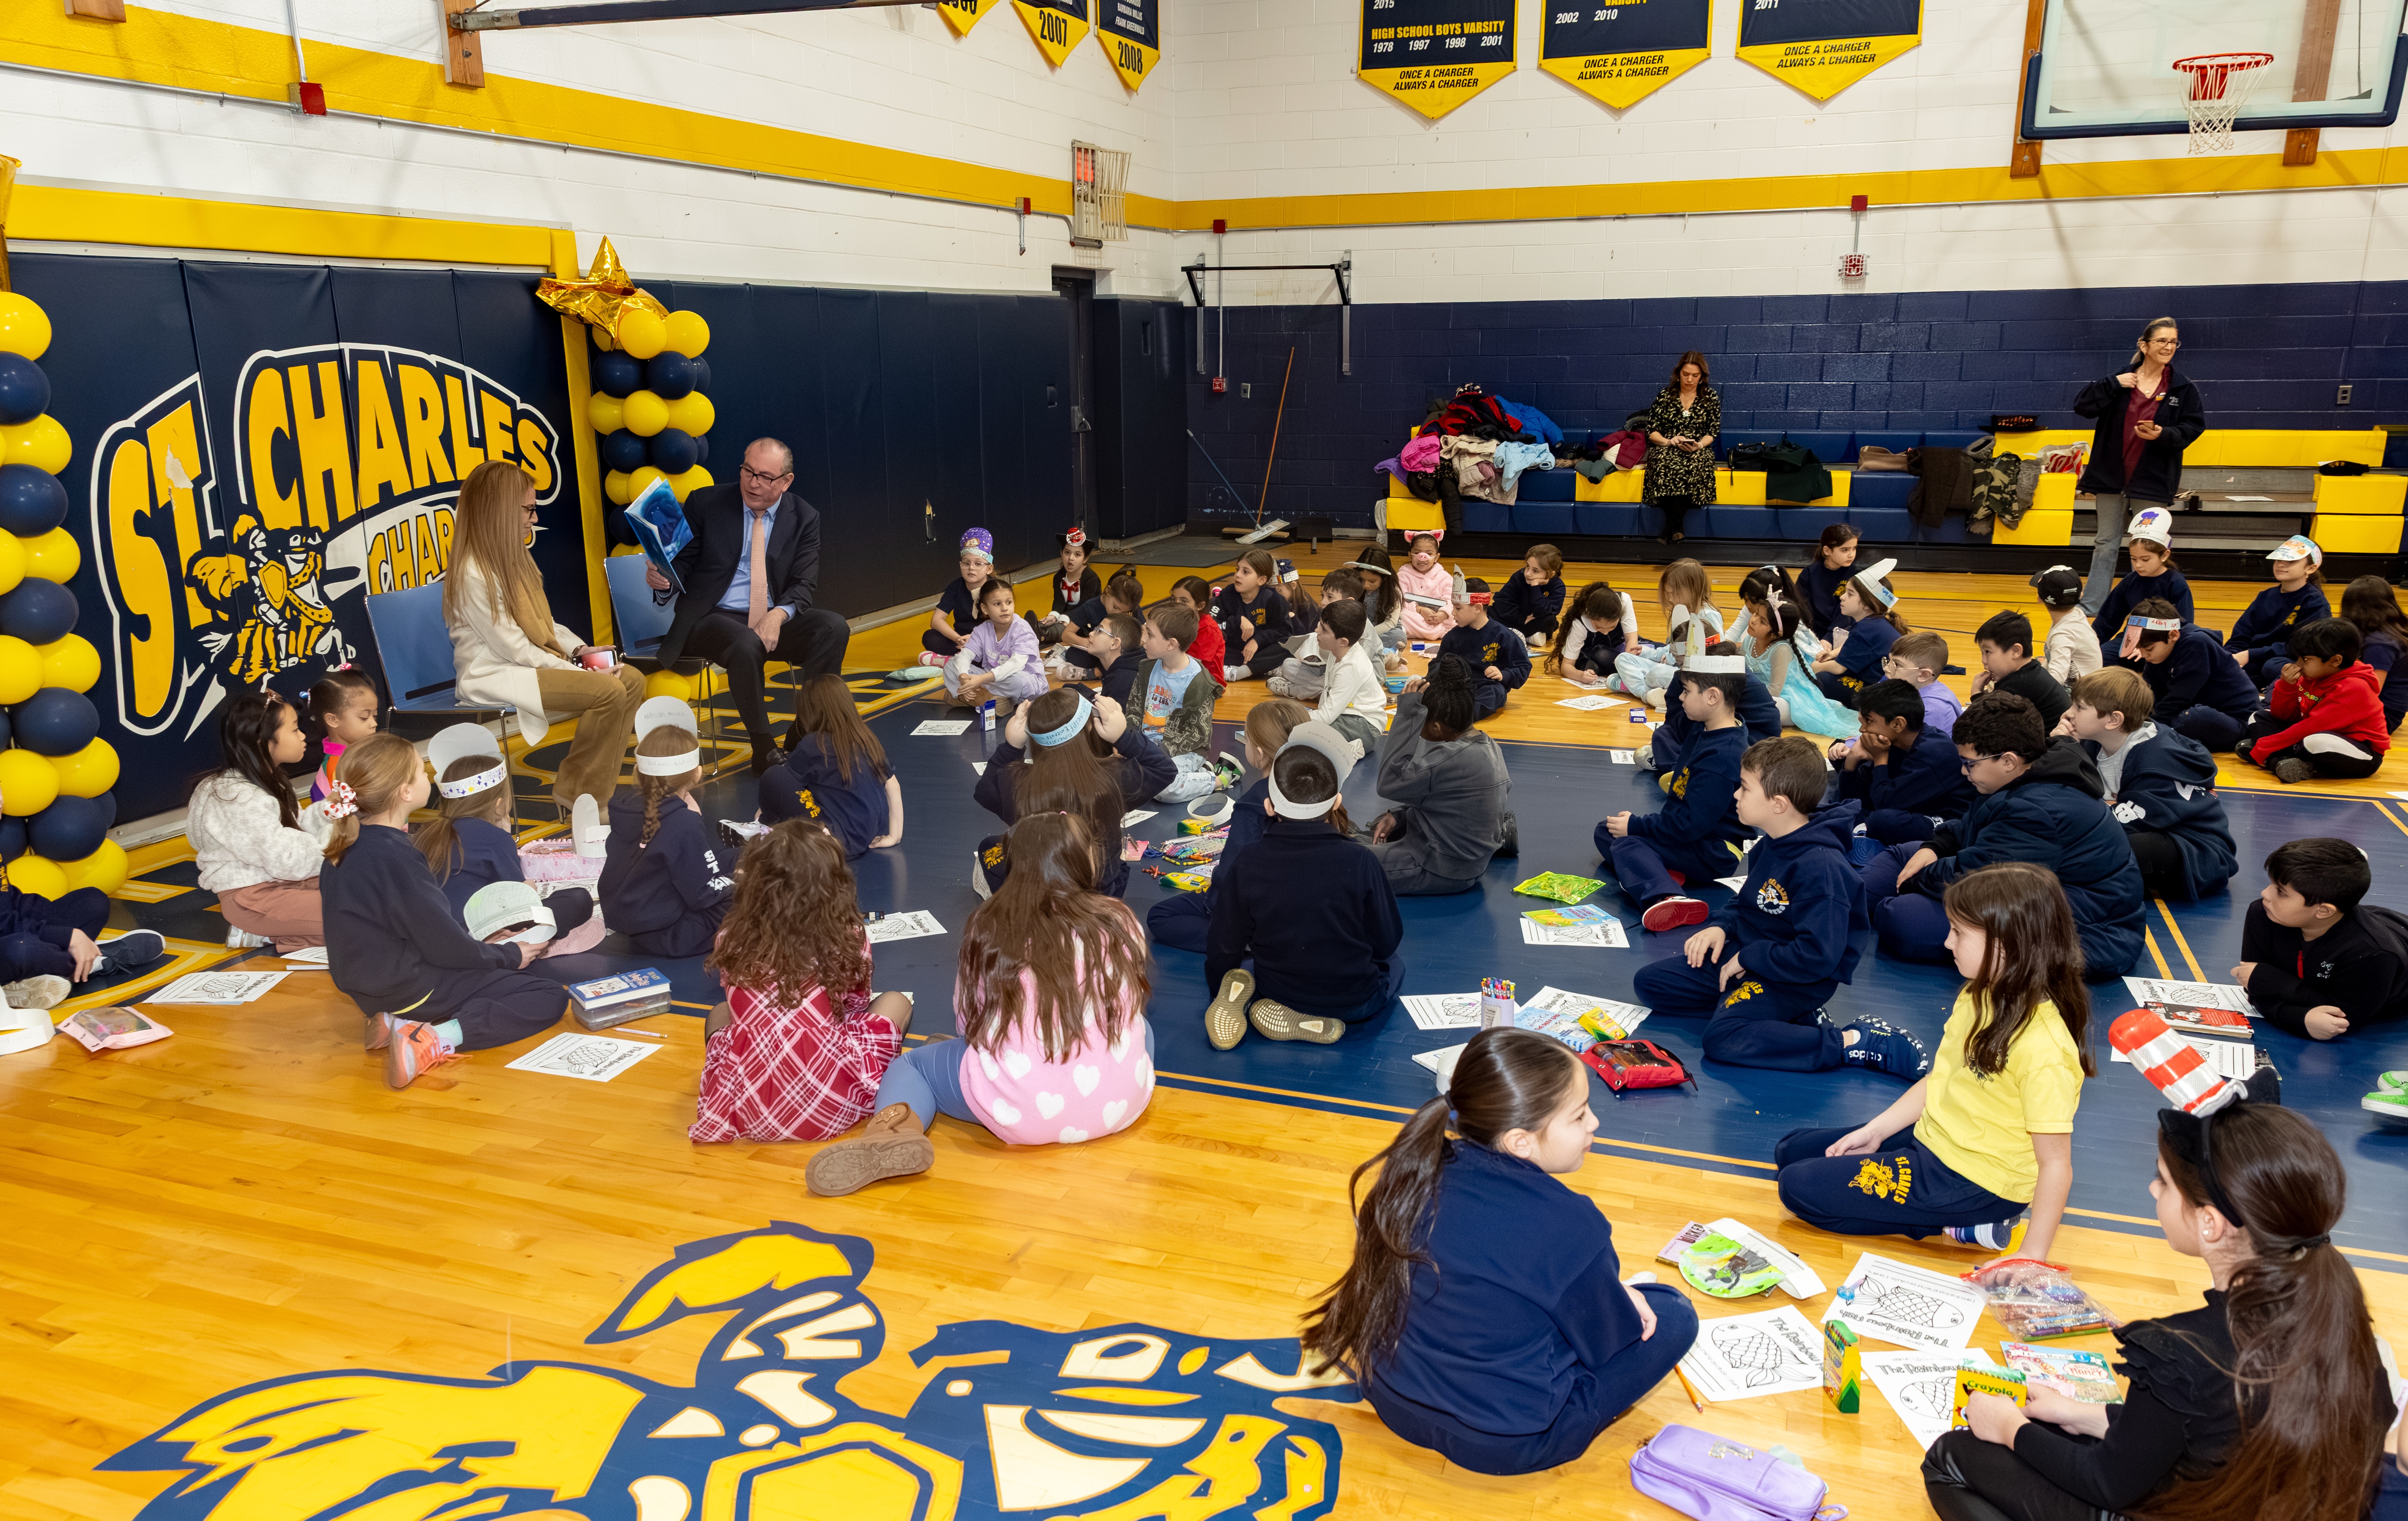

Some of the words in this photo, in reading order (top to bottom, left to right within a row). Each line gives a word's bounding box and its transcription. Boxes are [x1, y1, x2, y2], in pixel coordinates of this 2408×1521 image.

[1373, 0, 1394, 9] 2015
[1755, 0, 1779, 10] 2011
[1555, 12, 1579, 24] 2002
[1594, 9, 1618, 21] 2010
[1039, 10, 1067, 47] 2007
[1371, 27, 1395, 39] HIGH
[1397, 25, 1434, 38] SCHOOL
[1436, 23, 1461, 35] BOYS
[1464, 20, 1505, 33] VARSITY
[1373, 42, 1393, 52] 1978
[1409, 39, 1430, 50] 1997
[1445, 37, 1466, 49] 1998
[1481, 35, 1503, 46] 2001
[1784, 46, 1810, 56] ONCE
[1813, 45, 1820, 53] A
[1823, 42, 1871, 52] CHARGER
[1118, 40, 1143, 75] 2008
[1584, 58, 1609, 68] ONCE
[1611, 58, 1617, 67] A
[1620, 55, 1664, 65] CHARGER
[1777, 57, 1817, 68] ALWAYS
[1818, 56, 1825, 65] A
[1829, 54, 1876, 65] CHARGER
[1400, 70, 1423, 79] ONCE
[1434, 67, 1474, 77] CHARGER
[1578, 69, 1613, 80] ALWAYS
[1616, 69, 1622, 78] A
[1625, 66, 1669, 77] CHARGER
[1393, 81, 1427, 91] ALWAYS
[1429, 81, 1435, 89] A
[1438, 79, 1478, 88] CHARGER
[249, 360, 552, 531] CHARLES
[1515, 1011, 1532, 1022] DIARY
[1894, 1168, 1911, 1204] CHARLS
[1675, 1223, 1705, 1244] WICKED
[1839, 1309, 1864, 1321] Fish
[1866, 1318, 1922, 1340] Rainbow
[1768, 1317, 1789, 1331] The
[1781, 1331, 1820, 1362] Rainbow
[1924, 1335, 1949, 1348] The
[1876, 1364, 1905, 1374] The
[1903, 1363, 1960, 1374] Rainbow
[1967, 1380, 2013, 1397] Crayola
